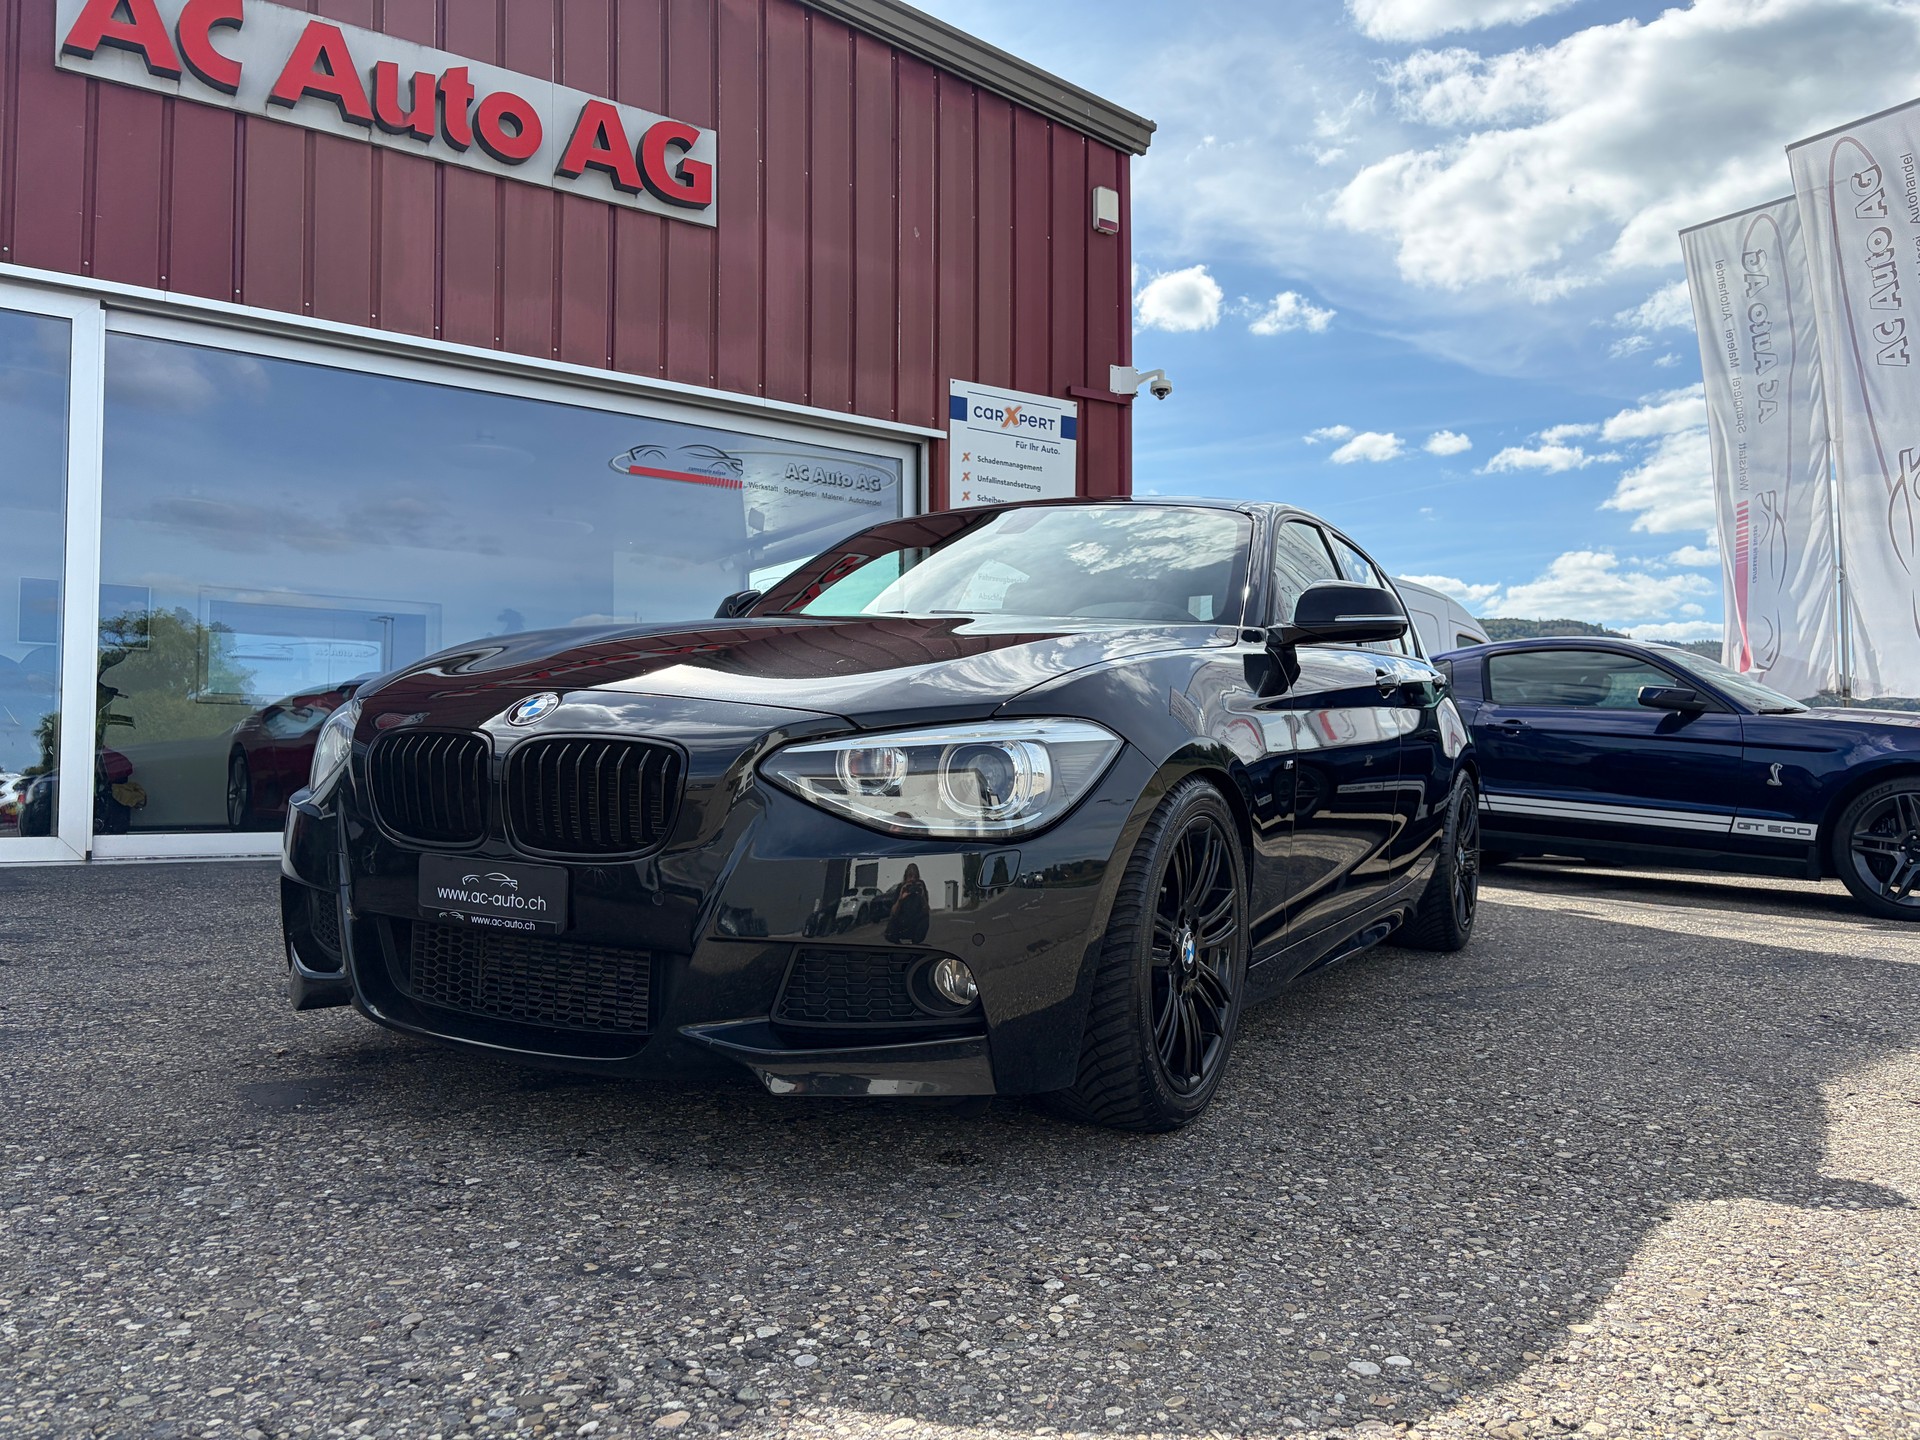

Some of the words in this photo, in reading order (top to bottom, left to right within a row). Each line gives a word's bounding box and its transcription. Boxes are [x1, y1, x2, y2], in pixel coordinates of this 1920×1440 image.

[62, 0, 243, 95] AC
[269, 20, 543, 165] Auto
[555, 99, 712, 210] AG
[1850, 164, 1888, 219] AG
[1900, 152, 1920, 224] Autohandel
[1864, 226, 1902, 311] Auto
[1871, 318, 1910, 367] AC
[1015, 440, 1027, 450] Für
[1029, 442, 1039, 452] Ihr
[1041, 445, 1061, 455] Auto.
[977, 455, 1043, 472] Schadenmanagement
[785, 462, 810, 481] AC
[813, 466, 854, 488] Auto
[856, 473, 882, 492] AG
[977, 475, 1042, 492] Unfallinstandsetzung
[748, 481, 779, 492] Werkstatt
[783, 486, 817, 498] Spenglerei
[822, 492, 845, 501] Malerei
[848, 496, 882, 506] Autohandel
[1737, 822, 1764, 831] GT
[1767, 825, 1812, 836] 500
[437, 887, 547, 911] www.ac-auto.ch
[471, 915, 536, 931] www.ac-auto.ch
